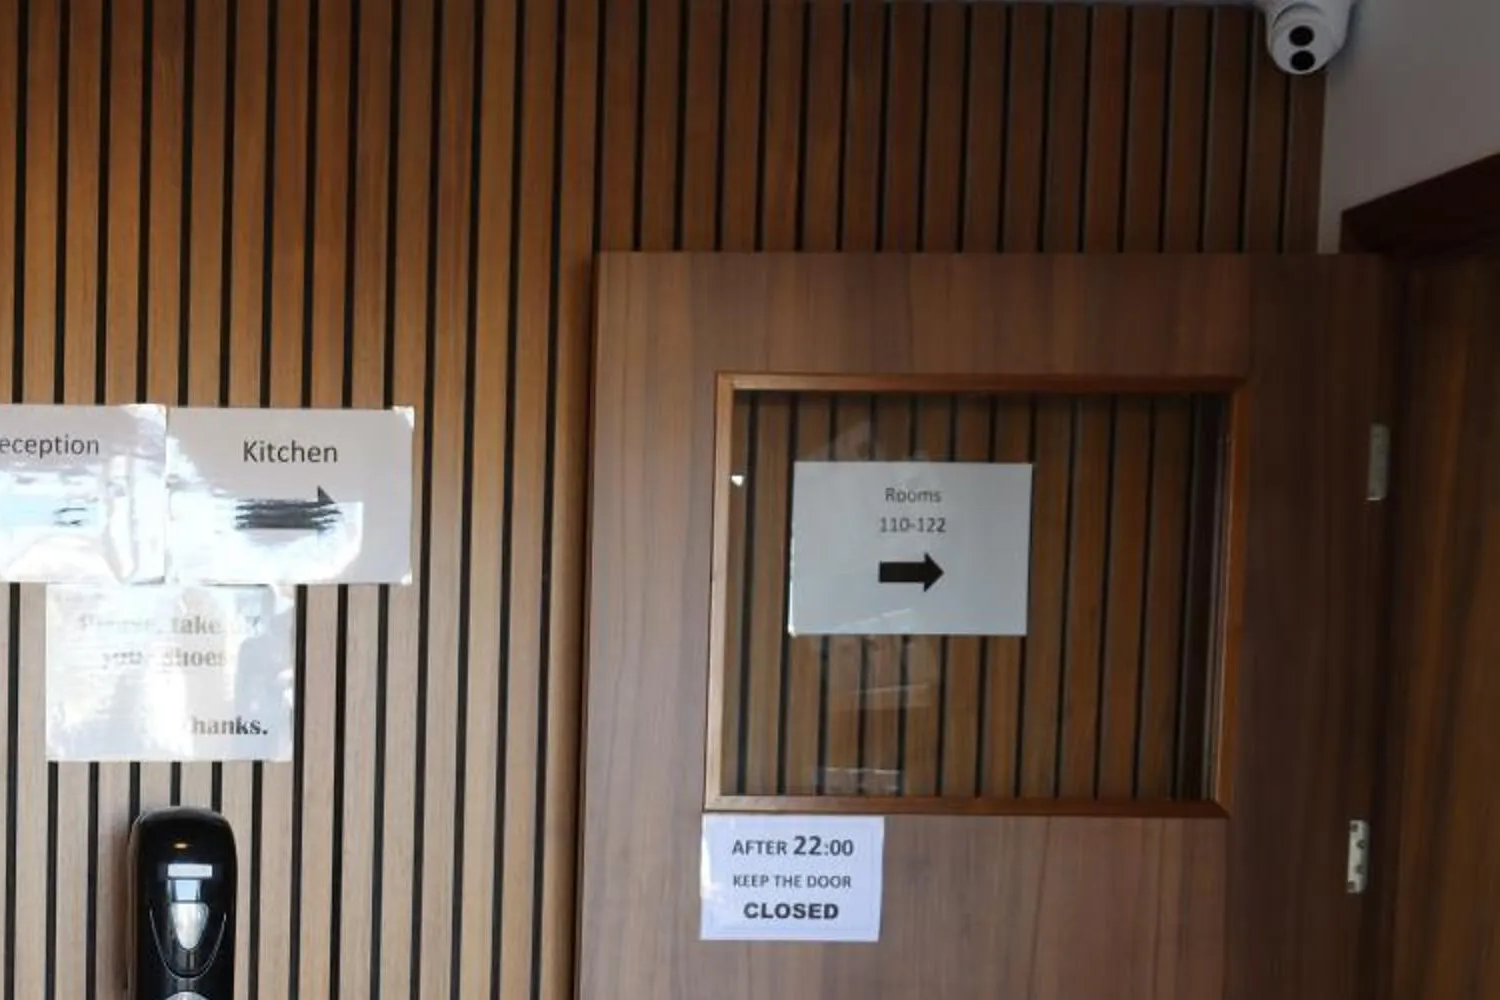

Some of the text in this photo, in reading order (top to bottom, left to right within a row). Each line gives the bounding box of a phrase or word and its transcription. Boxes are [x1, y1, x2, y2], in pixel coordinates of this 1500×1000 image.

[243, 439, 338, 464] Kitchen
[885, 487, 942, 503] Rooms
[879, 517, 946, 533] 110-122
[187, 715, 268, 736] hanks.
[732, 835, 854, 856] AFTER 22:00
[733, 875, 852, 889] KEEP THE DOOR
[743, 903, 839, 920] CLOSED
